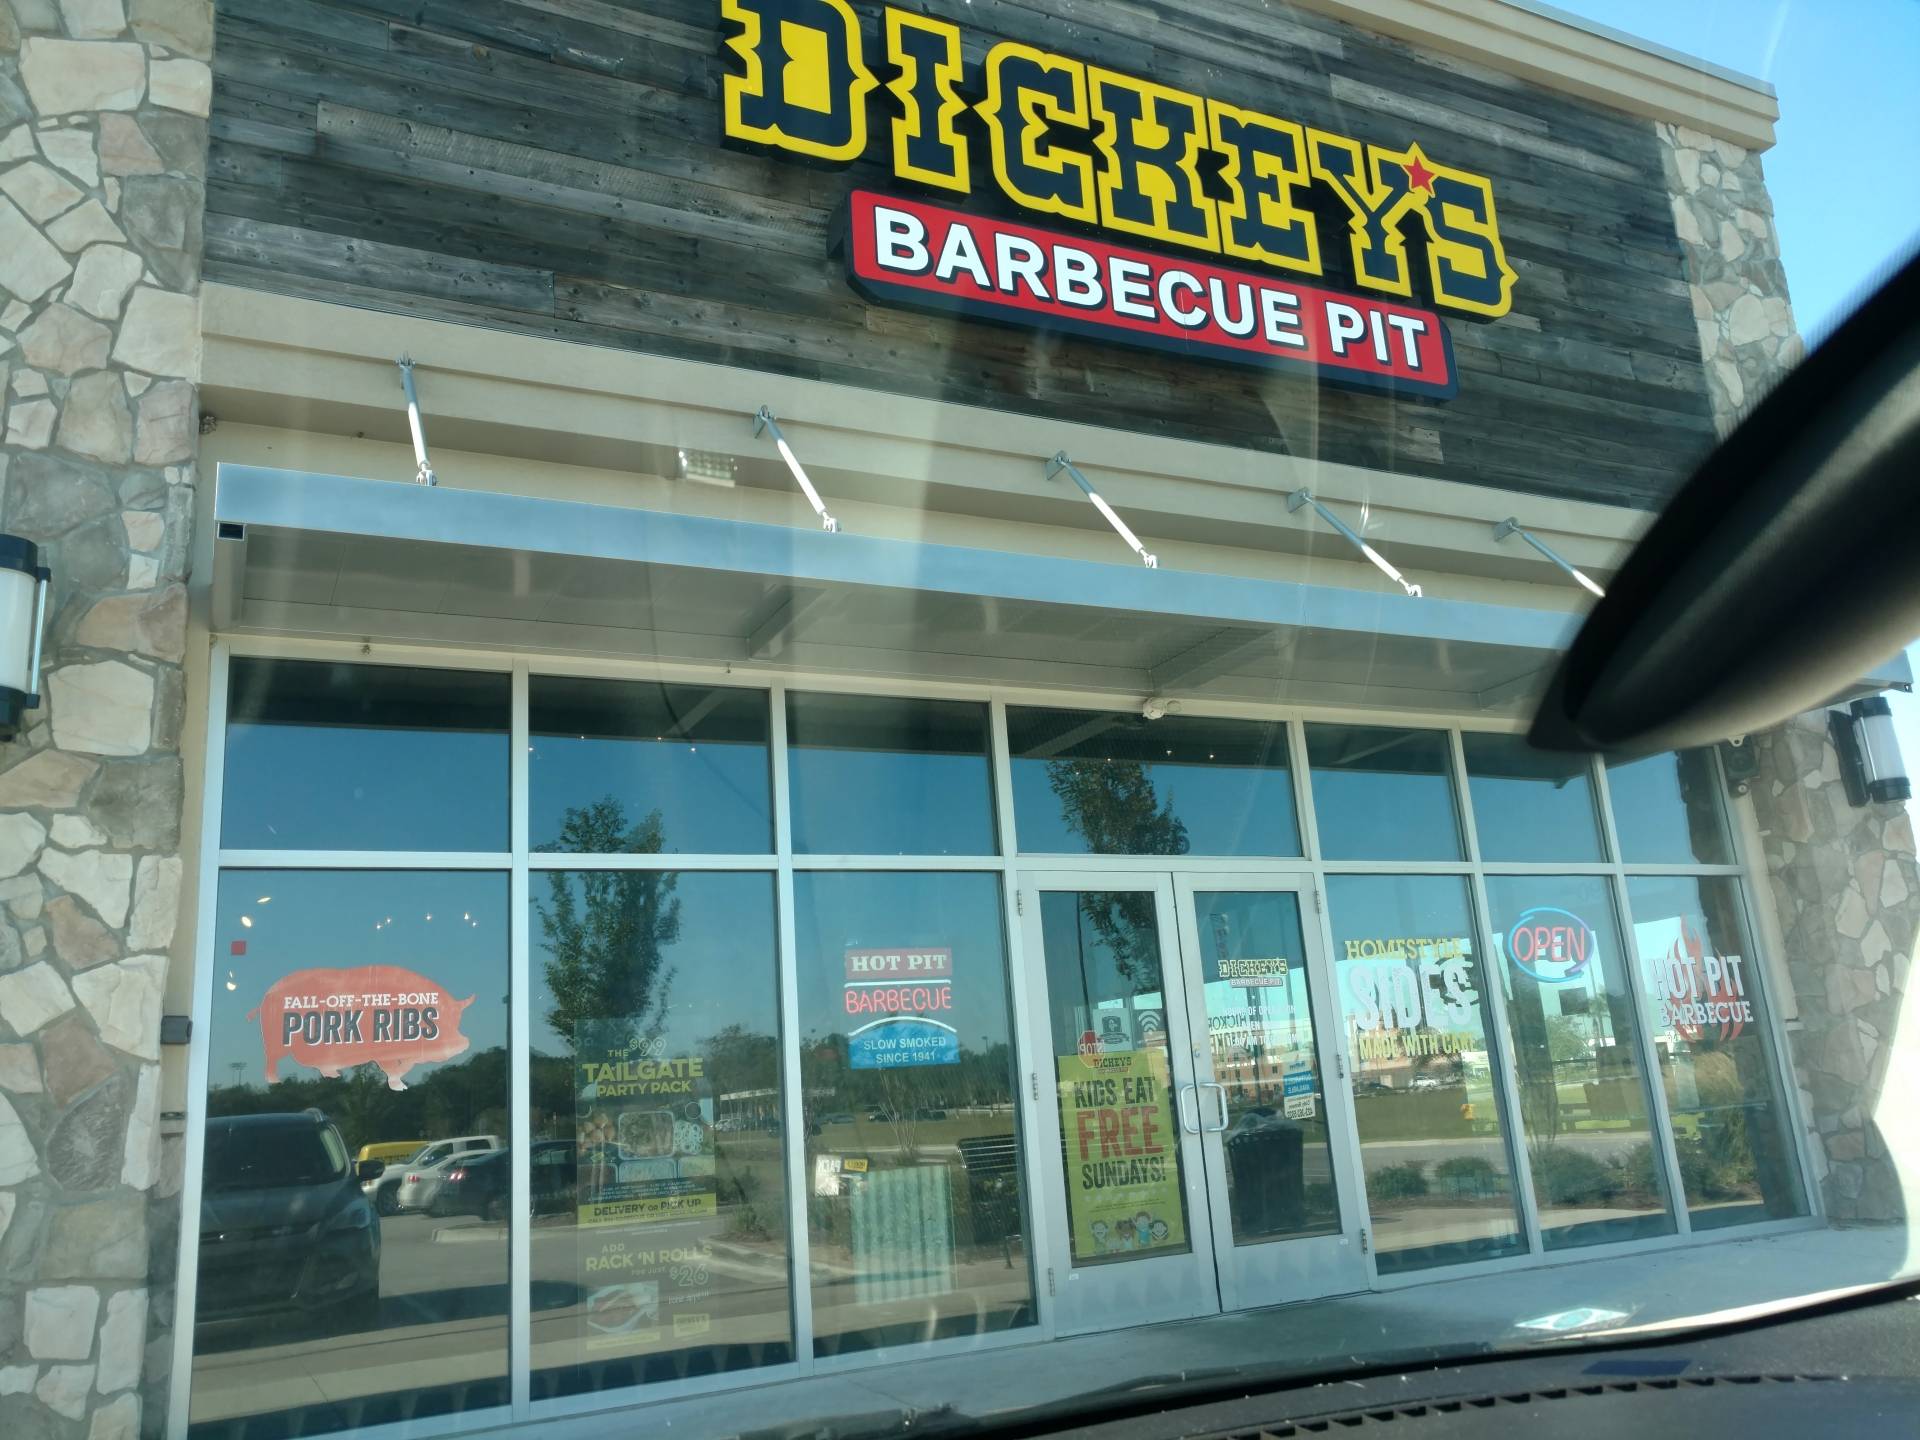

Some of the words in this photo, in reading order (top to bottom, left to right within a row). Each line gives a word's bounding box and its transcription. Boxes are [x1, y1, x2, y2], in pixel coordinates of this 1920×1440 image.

[873, 204, 1306, 349] BARBECUE
[1326, 299, 1428, 371] PIT
[1513, 926, 1585, 961] OPEN
[851, 955, 900, 972] HOT
[907, 954, 947, 970] PIT
[1651, 957, 1698, 1000] HOT
[1703, 956, 1745, 996] PIT
[284, 993, 439, 1010] FALL-OFF-THE-BONE
[845, 987, 952, 1014] BARBECUE
[282, 1010, 364, 1047] PORK
[373, 1007, 440, 1042] RIBS
[1660, 1001, 1754, 1027] BARBECUE
[608, 1049, 629, 1057] THE
[629, 1037, 667, 1056] $99
[863, 1037, 897, 1050] SLOW
[899, 1036, 947, 1050] SMOKED
[1359, 1036, 1399, 1060] MADE
[1402, 1034, 1438, 1056] WITH
[582, 1057, 704, 1083] TAILGATE
[876, 1052, 909, 1064] SINCE
[912, 1051, 936, 1062] 1941
[596, 1082, 649, 1097] PARTY
[651, 1080, 692, 1093] PACK
[1073, 1078, 1117, 1109] KIDS
[1123, 1076, 1156, 1104] EAT
[1076, 1105, 1164, 1161] FREE
[1082, 1156, 1167, 1190] SUNDAYS!
[594, 1203, 646, 1217] DELIVERY
[686, 1198, 701, 1207] UP
[586, 1252, 634, 1272] RACK
[659, 1244, 713, 1264] ROLLS
[602, 1243, 625, 1254] ADD
